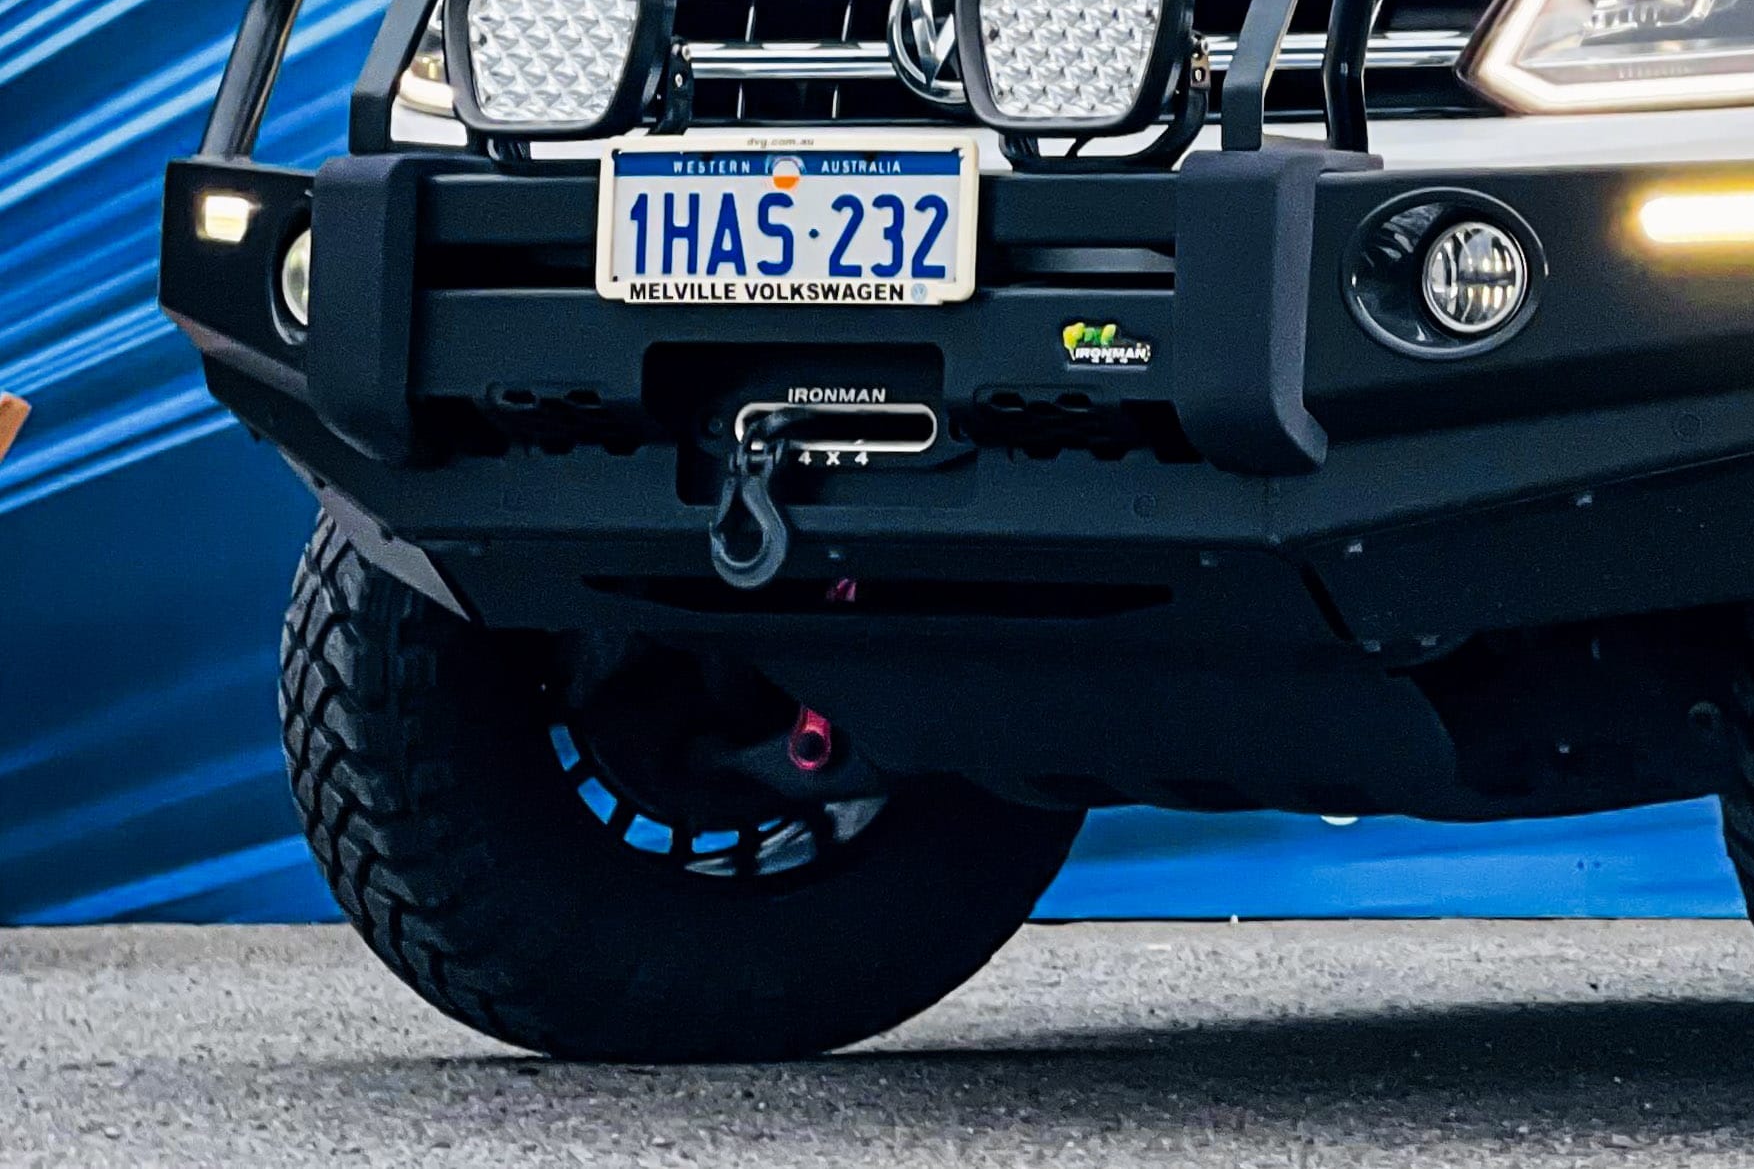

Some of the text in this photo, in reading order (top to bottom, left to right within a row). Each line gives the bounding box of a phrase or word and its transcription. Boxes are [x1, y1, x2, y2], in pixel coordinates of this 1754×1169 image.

[746, 137, 815, 148] dvg.com.au
[673, 160, 901, 174] WESTERN AUSTRALIA
[629, 283, 904, 302] MELVILLE VOLKSWAGEN
[1075, 346, 1147, 359] IRONMAN
[787, 388, 886, 403] IRONMAN
